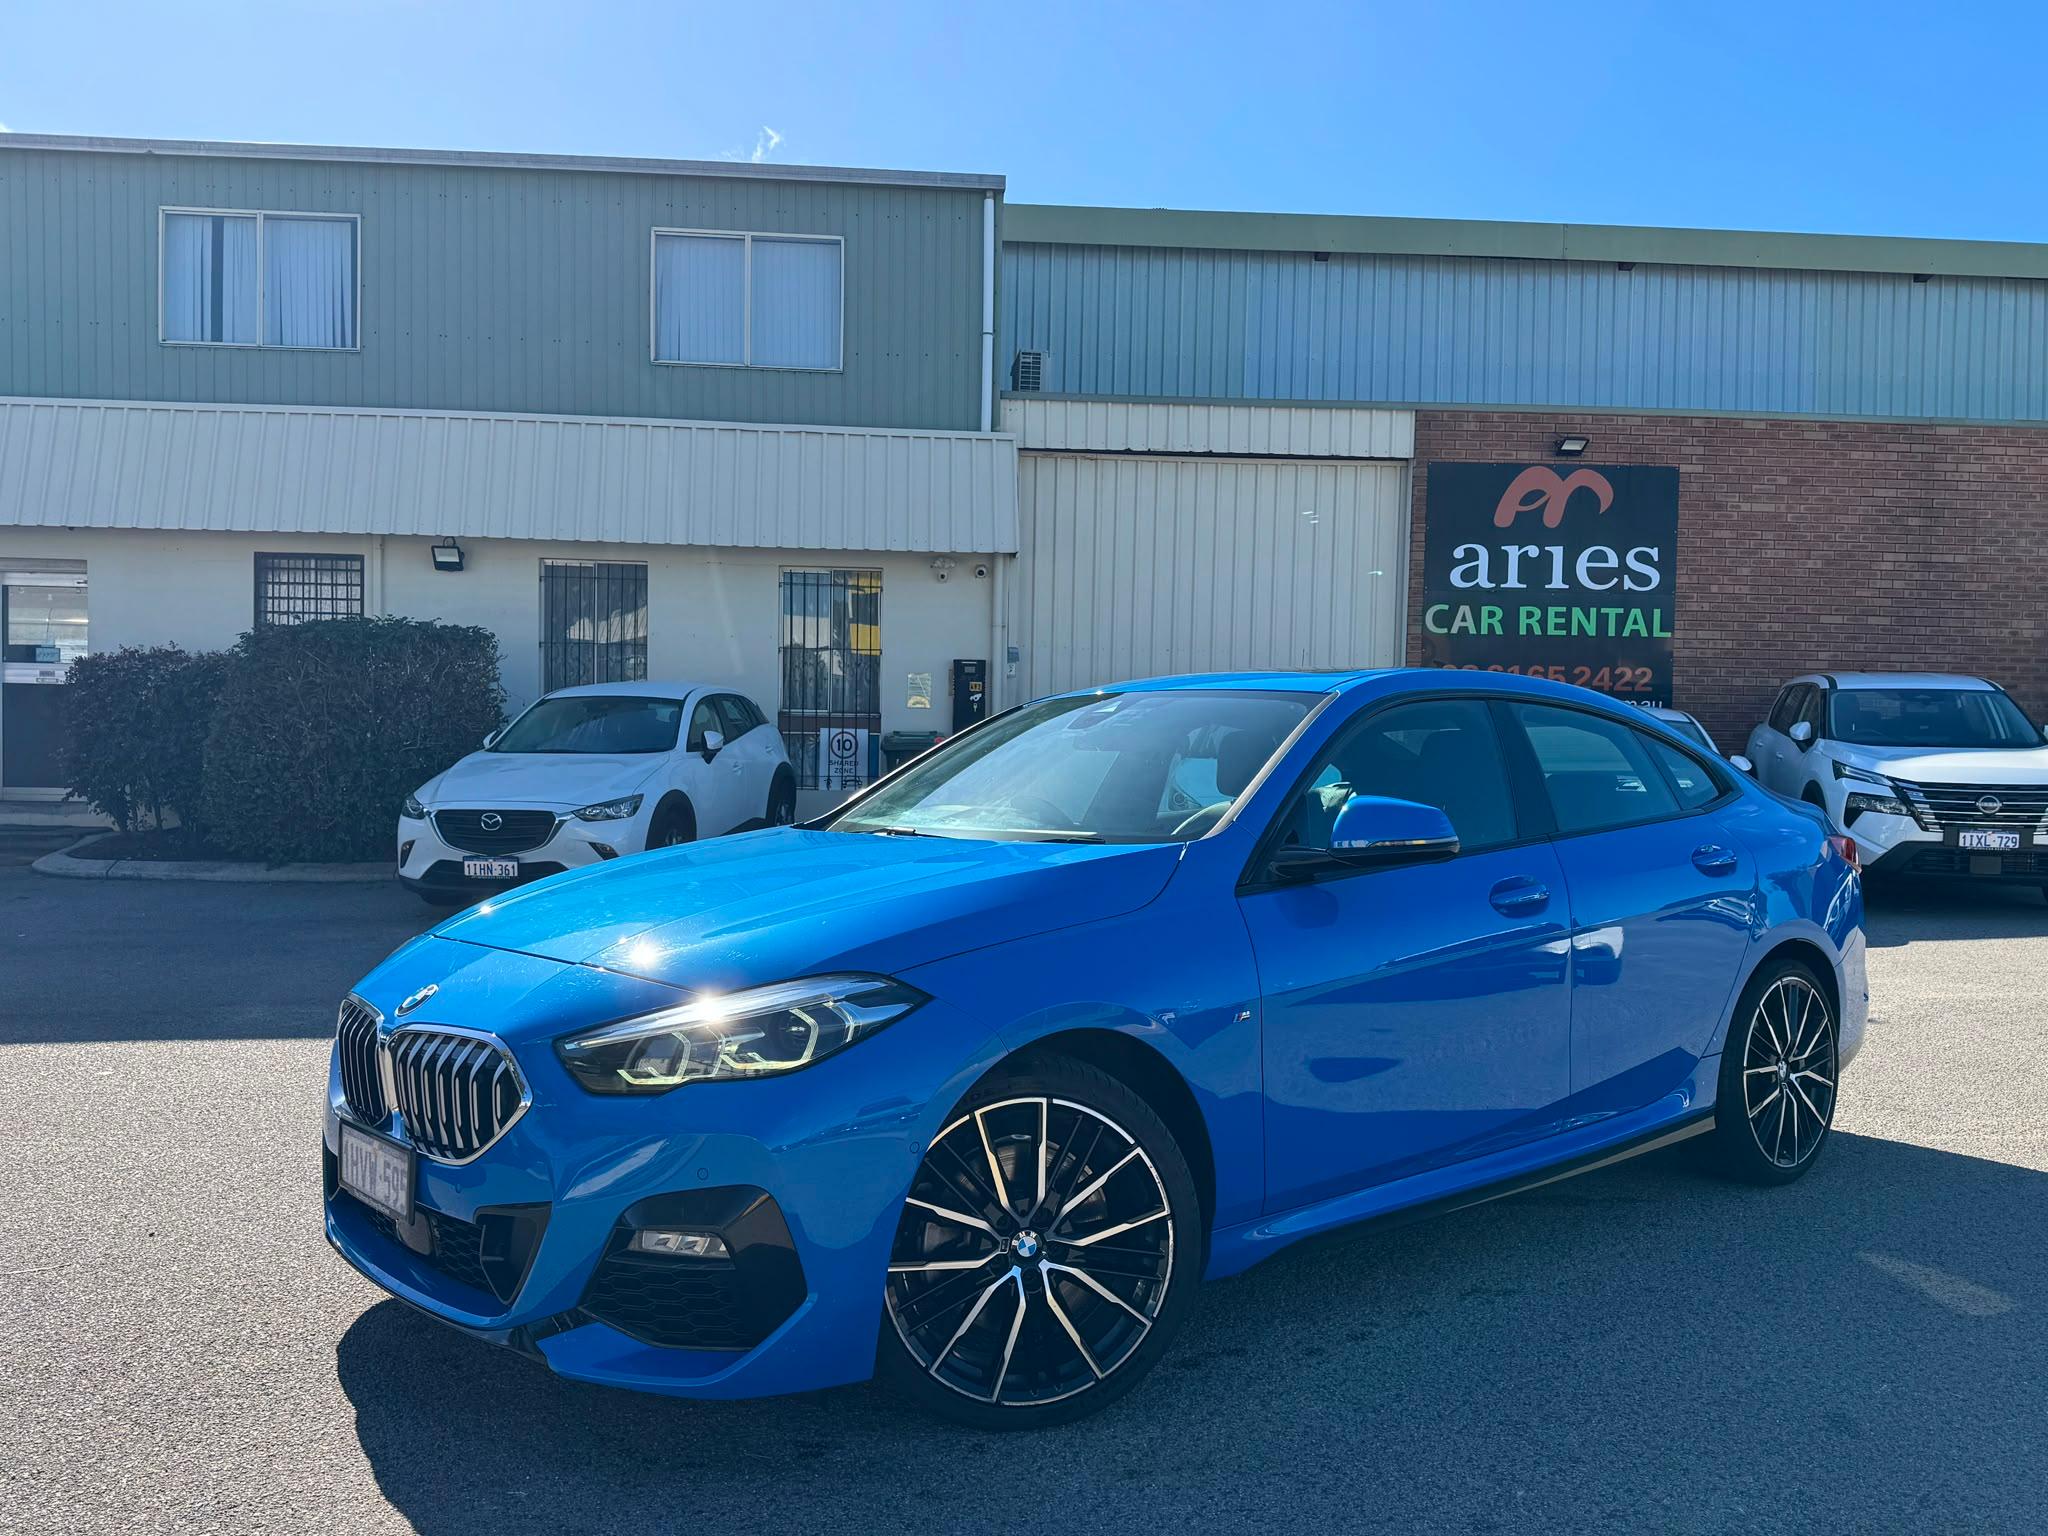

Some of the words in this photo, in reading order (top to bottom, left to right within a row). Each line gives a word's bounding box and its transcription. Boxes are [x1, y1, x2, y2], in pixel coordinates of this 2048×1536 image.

[1450, 543, 1661, 592] aries
[1425, 604, 1503, 635] CAR
[1519, 606, 1672, 638] RENTAL
[1572, 666, 1653, 692] 2422
[837, 739, 852, 751] 10
